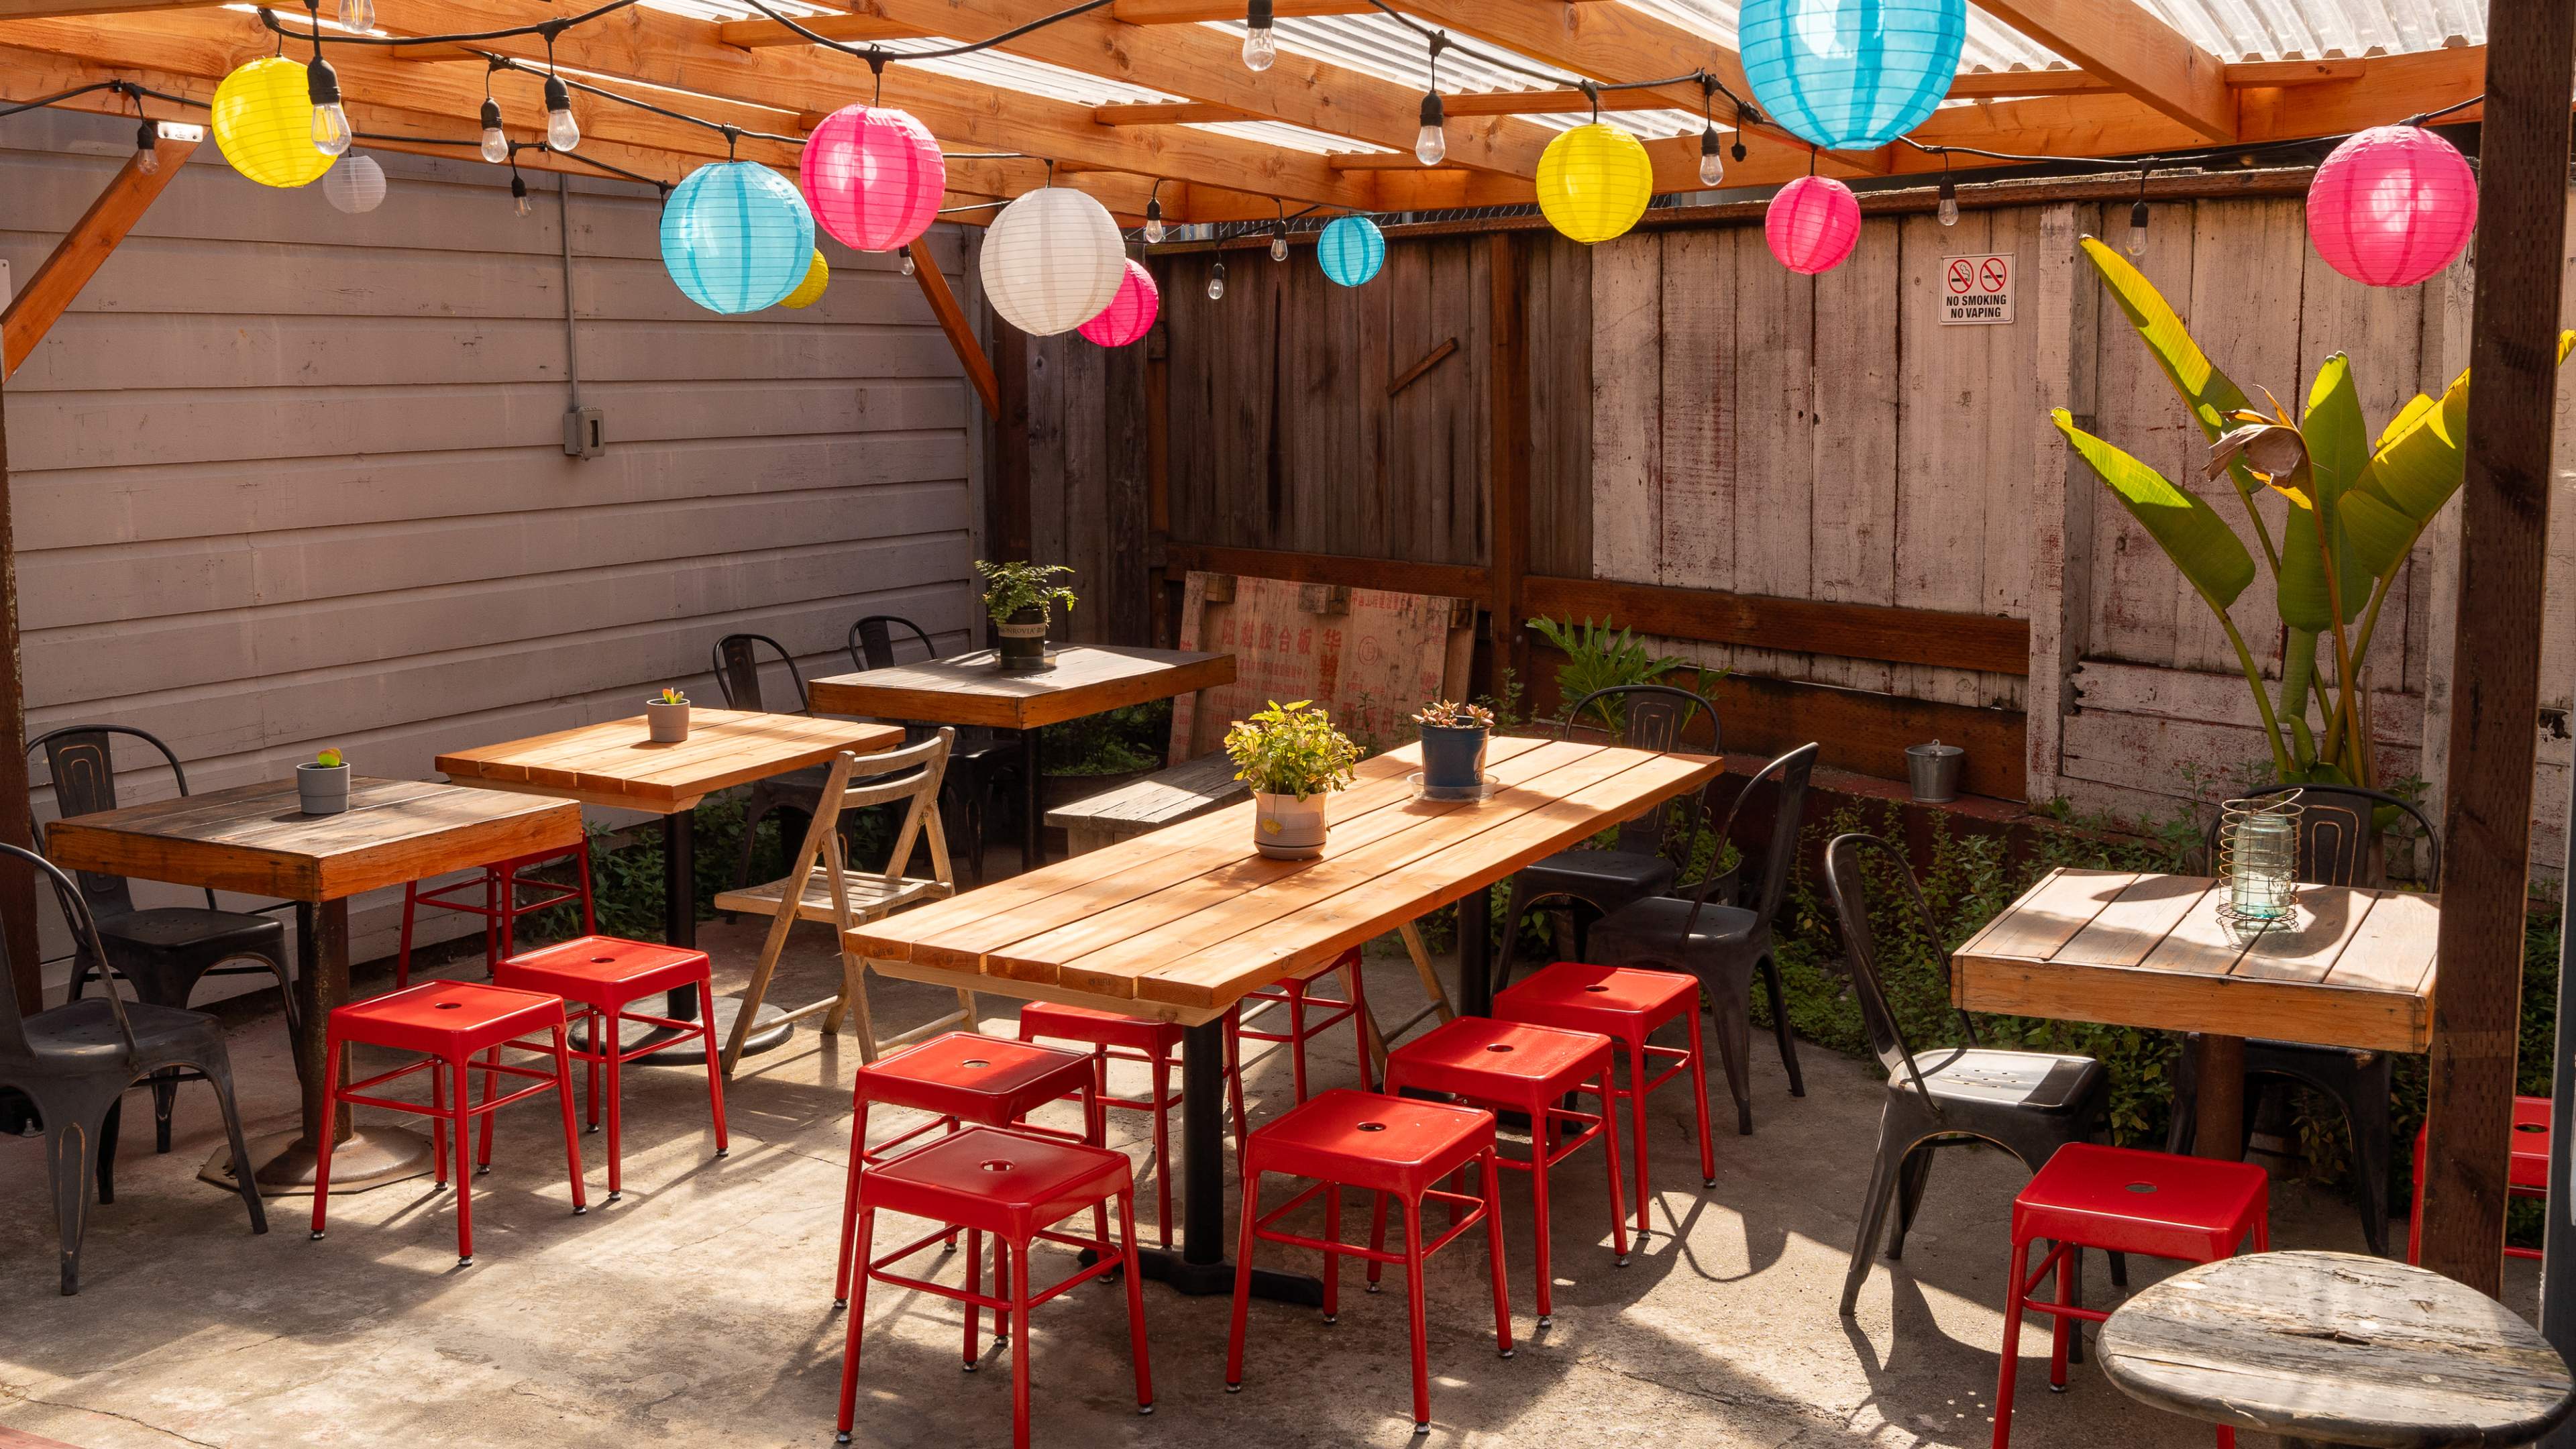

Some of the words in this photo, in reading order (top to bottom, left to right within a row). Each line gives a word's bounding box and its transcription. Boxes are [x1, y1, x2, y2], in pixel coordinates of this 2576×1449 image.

[1946, 296, 1959, 306] NO
[1962, 294, 2006, 306] SMOKING
[1951, 308, 1964, 318] NO
[1966, 307, 2001, 318] VAPING
